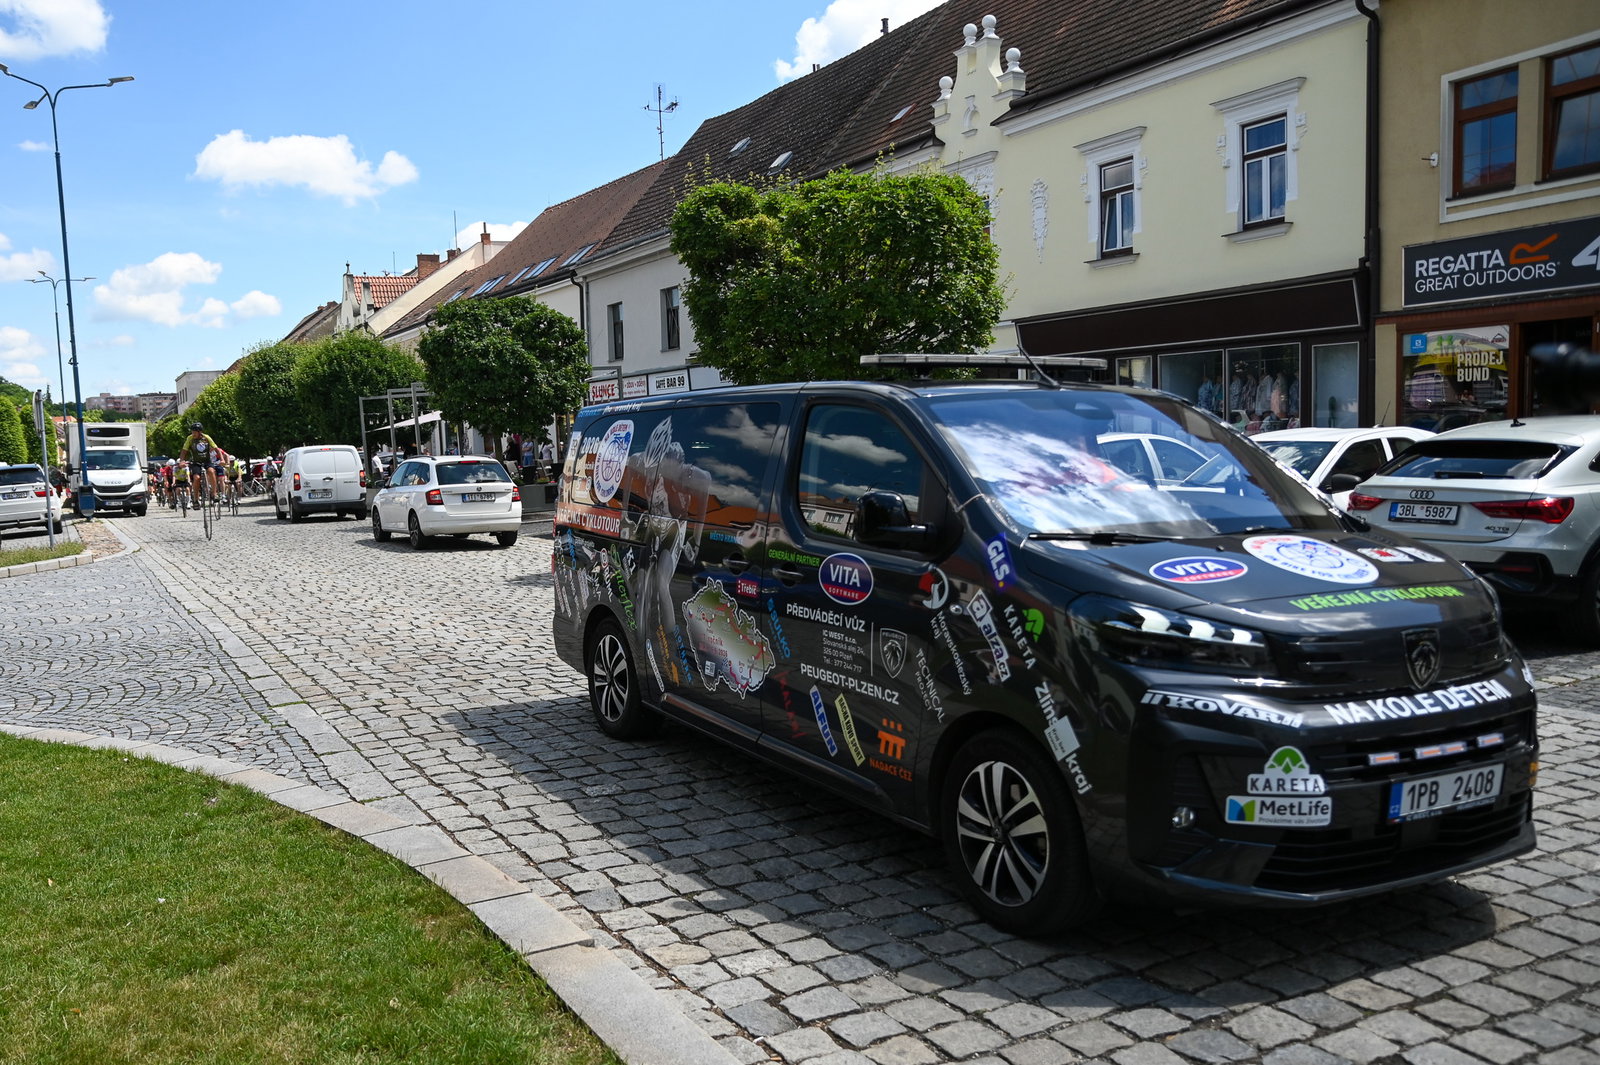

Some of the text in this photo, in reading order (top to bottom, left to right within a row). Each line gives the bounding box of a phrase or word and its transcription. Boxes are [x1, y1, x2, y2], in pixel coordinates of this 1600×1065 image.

[1415, 249, 1505, 278] REGATTA
[1415, 262, 1557, 293] GREAT OUTDOORS
[1457, 350, 1504, 368] PRODEJ
[667, 376, 677, 388] BAR
[677, 375, 685, 387] 99
[1456, 367, 1490, 382] BUND
[581, 513, 620, 534] CYKLOTOUR
[1399, 504, 1416, 517] 3BL
[1424, 506, 1452, 519] 5987
[796, 552, 820, 567] PARTNER
[987, 540, 1010, 581] GLS
[1163, 560, 1229, 577] VITA
[829, 563, 861, 587] VITA
[828, 586, 859, 599] SOFTWARE
[1289, 584, 1465, 611] VEŘEJNÁ CYKLOTOUR
[786, 602, 866, 632] PŘEDVÁDĚCÍ VŮZ
[770, 611, 791, 658] SULKO
[828, 630, 844, 641] WEST
[1004, 604, 1036, 670] KARETA
[936, 610, 973, 696] Moravskoslezský
[982, 623, 1008, 679] alza.cz
[800, 663, 900, 705] PEUGEOT-PLZEN.CZ
[915, 648, 946, 723] TECHNICAL
[1323, 679, 1512, 725] NA KOLE DĚTEM
[811, 690, 837, 754] ALFUN
[845, 720, 855, 741] KOVO
[851, 740, 864, 761] SPORT
[869, 757, 898, 777] NADACE
[1065, 753, 1092, 795] kraj
[1250, 777, 1323, 792] KARETA
[1407, 780, 1440, 811] 1PB
[1452, 769, 1496, 802] 2408
[1259, 800, 1330, 816] MetLife
